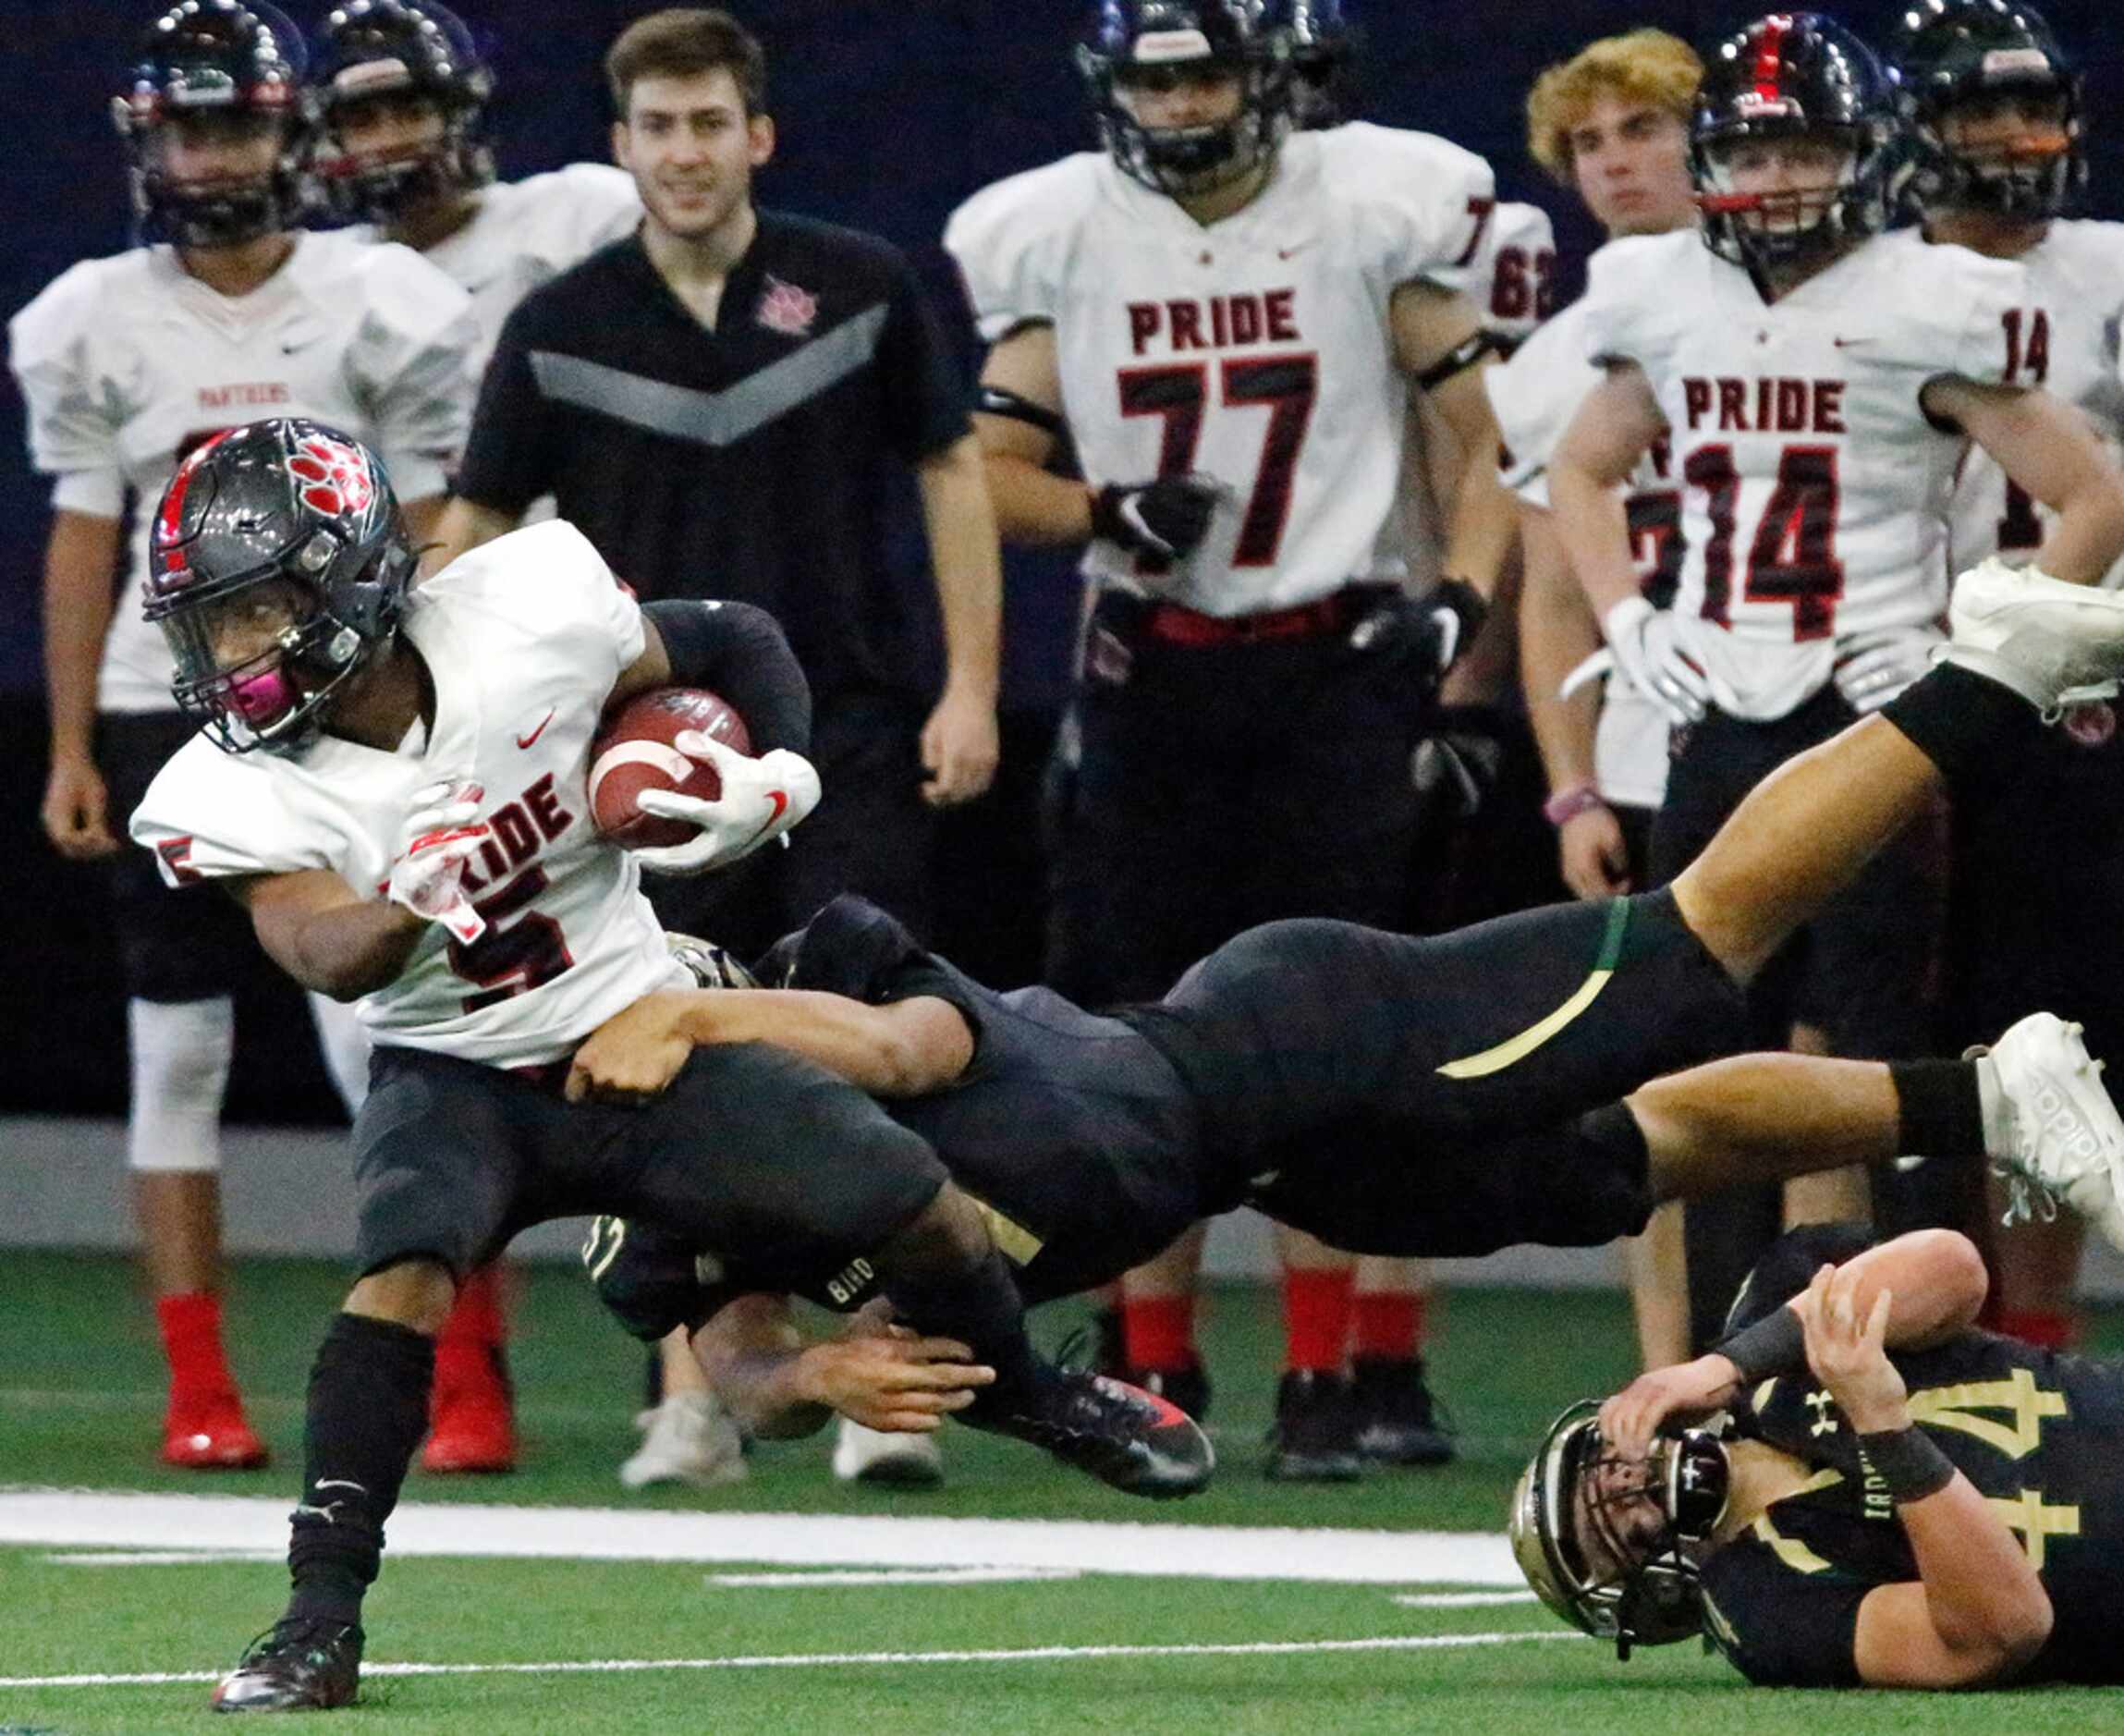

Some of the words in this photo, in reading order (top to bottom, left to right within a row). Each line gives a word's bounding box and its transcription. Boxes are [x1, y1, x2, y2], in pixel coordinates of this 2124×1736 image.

[1127, 287, 1300, 356] PRIDE
[2002, 308, 2049, 385] 14
[1117, 351, 1318, 575] 77
[1681, 376, 1848, 434] PRIDE
[1683, 442, 1845, 642] 14
[446, 862, 576, 1016] 5
[1907, 1367, 2080, 1571] 44
